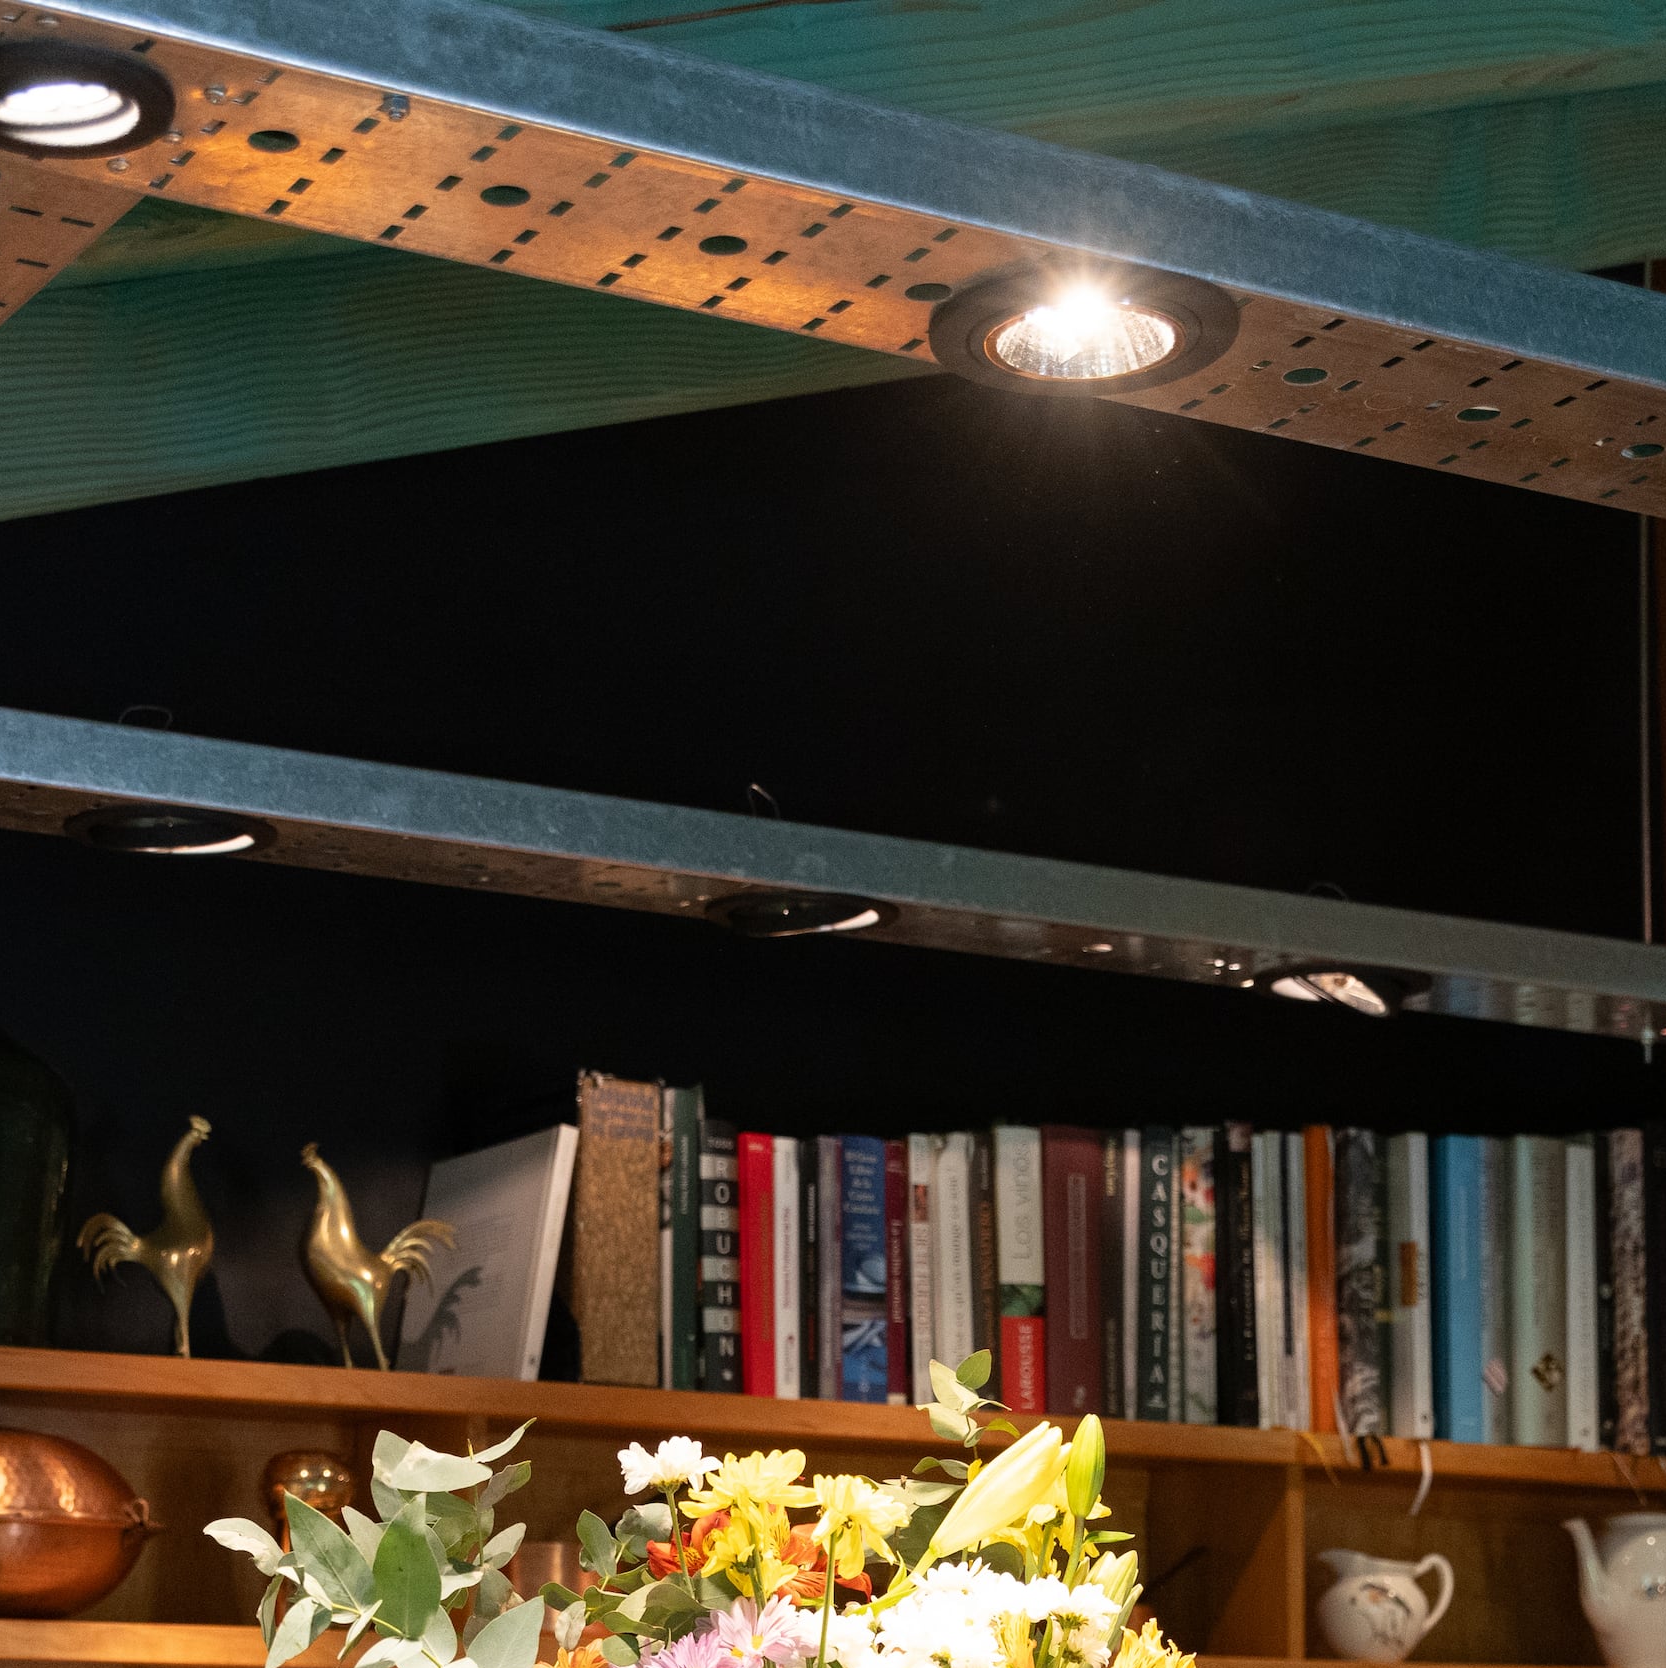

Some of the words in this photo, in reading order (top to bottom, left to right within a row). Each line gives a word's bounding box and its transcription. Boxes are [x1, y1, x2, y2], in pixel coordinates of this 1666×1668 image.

[713, 1158, 736, 1358] ROBUCHON
[1013, 1215, 1032, 1260] Los
[1018, 1322, 1035, 1410] LAROUSSE
